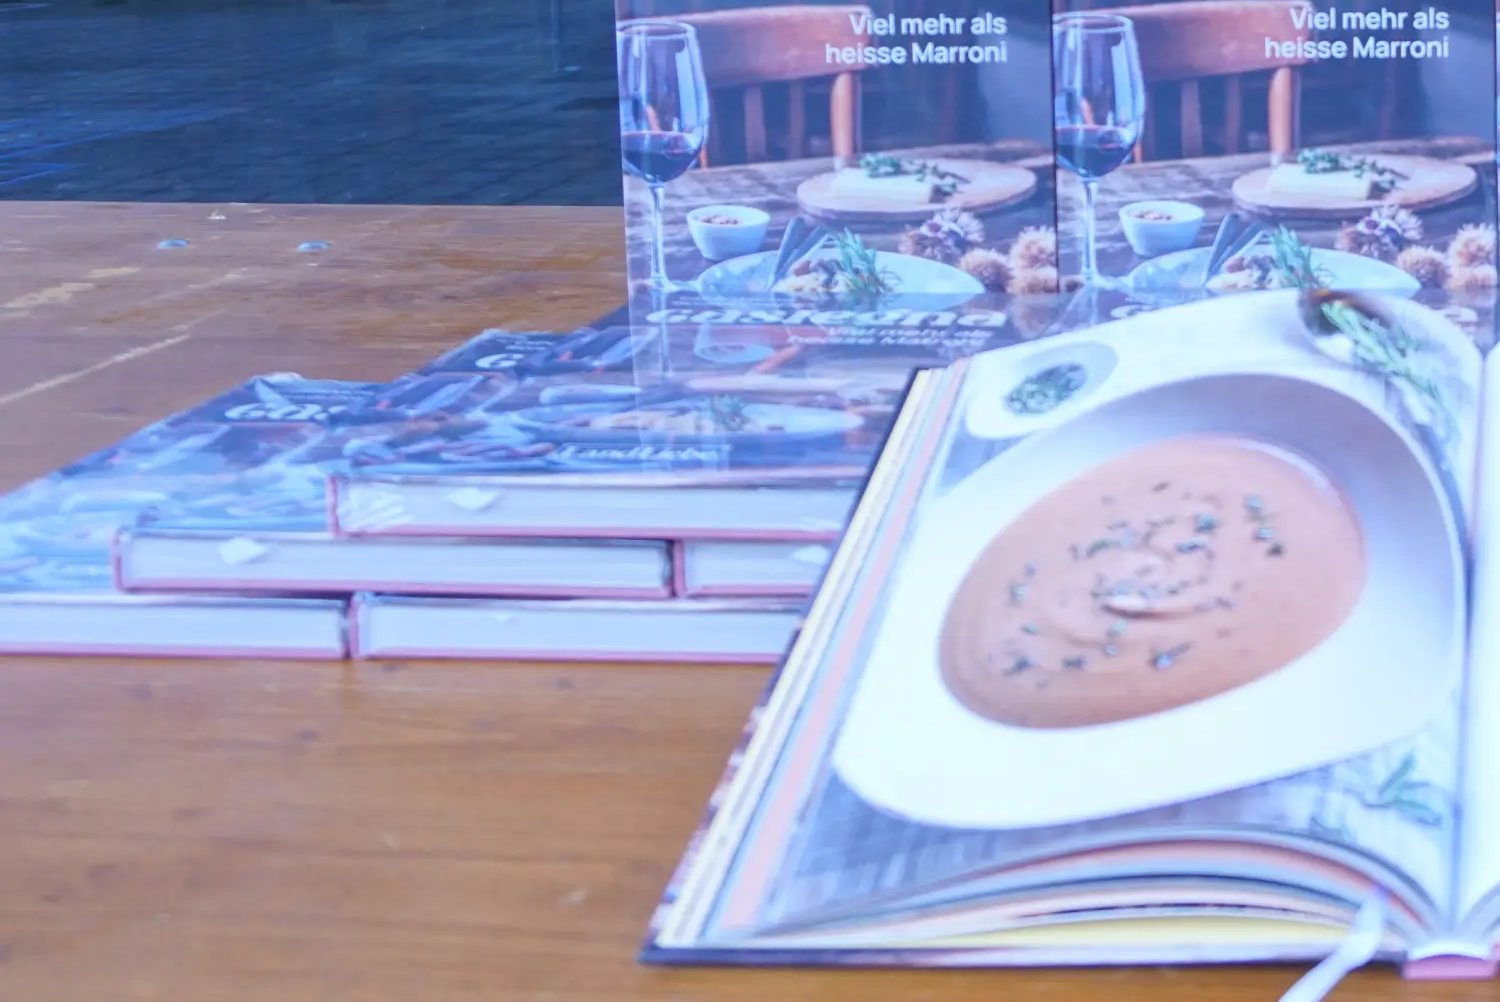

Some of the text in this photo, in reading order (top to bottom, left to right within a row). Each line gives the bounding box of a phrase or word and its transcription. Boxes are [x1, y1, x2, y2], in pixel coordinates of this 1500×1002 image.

[849, 14, 1007, 35] Viel mehr als
[1289, 8, 1450, 29] Viel mehr als
[825, 42, 1007, 64] heisse Marroni
[1265, 37, 1449, 59] heisse Marroni
